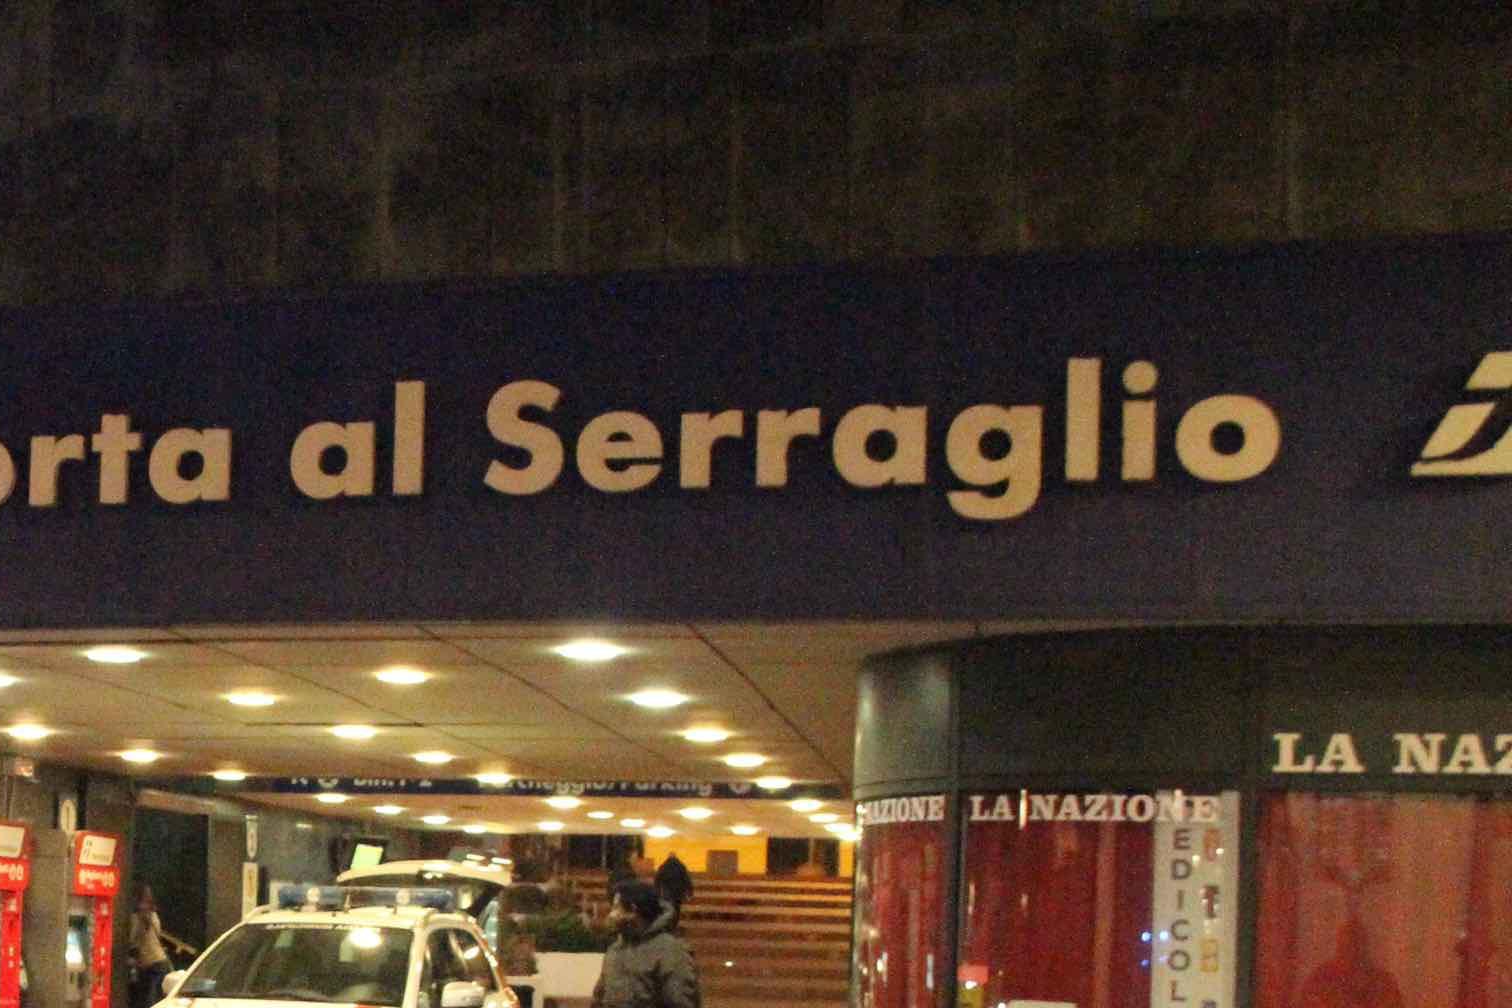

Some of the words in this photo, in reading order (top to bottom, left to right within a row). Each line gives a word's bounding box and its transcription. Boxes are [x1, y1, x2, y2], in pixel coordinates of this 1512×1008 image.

[289, 379, 426, 498] al
[482, 356, 1283, 521] Serraglio
[1272, 732, 1367, 773] LA
[970, 795, 1014, 822] LA
[1028, 794, 1219, 822] NAZIONE
